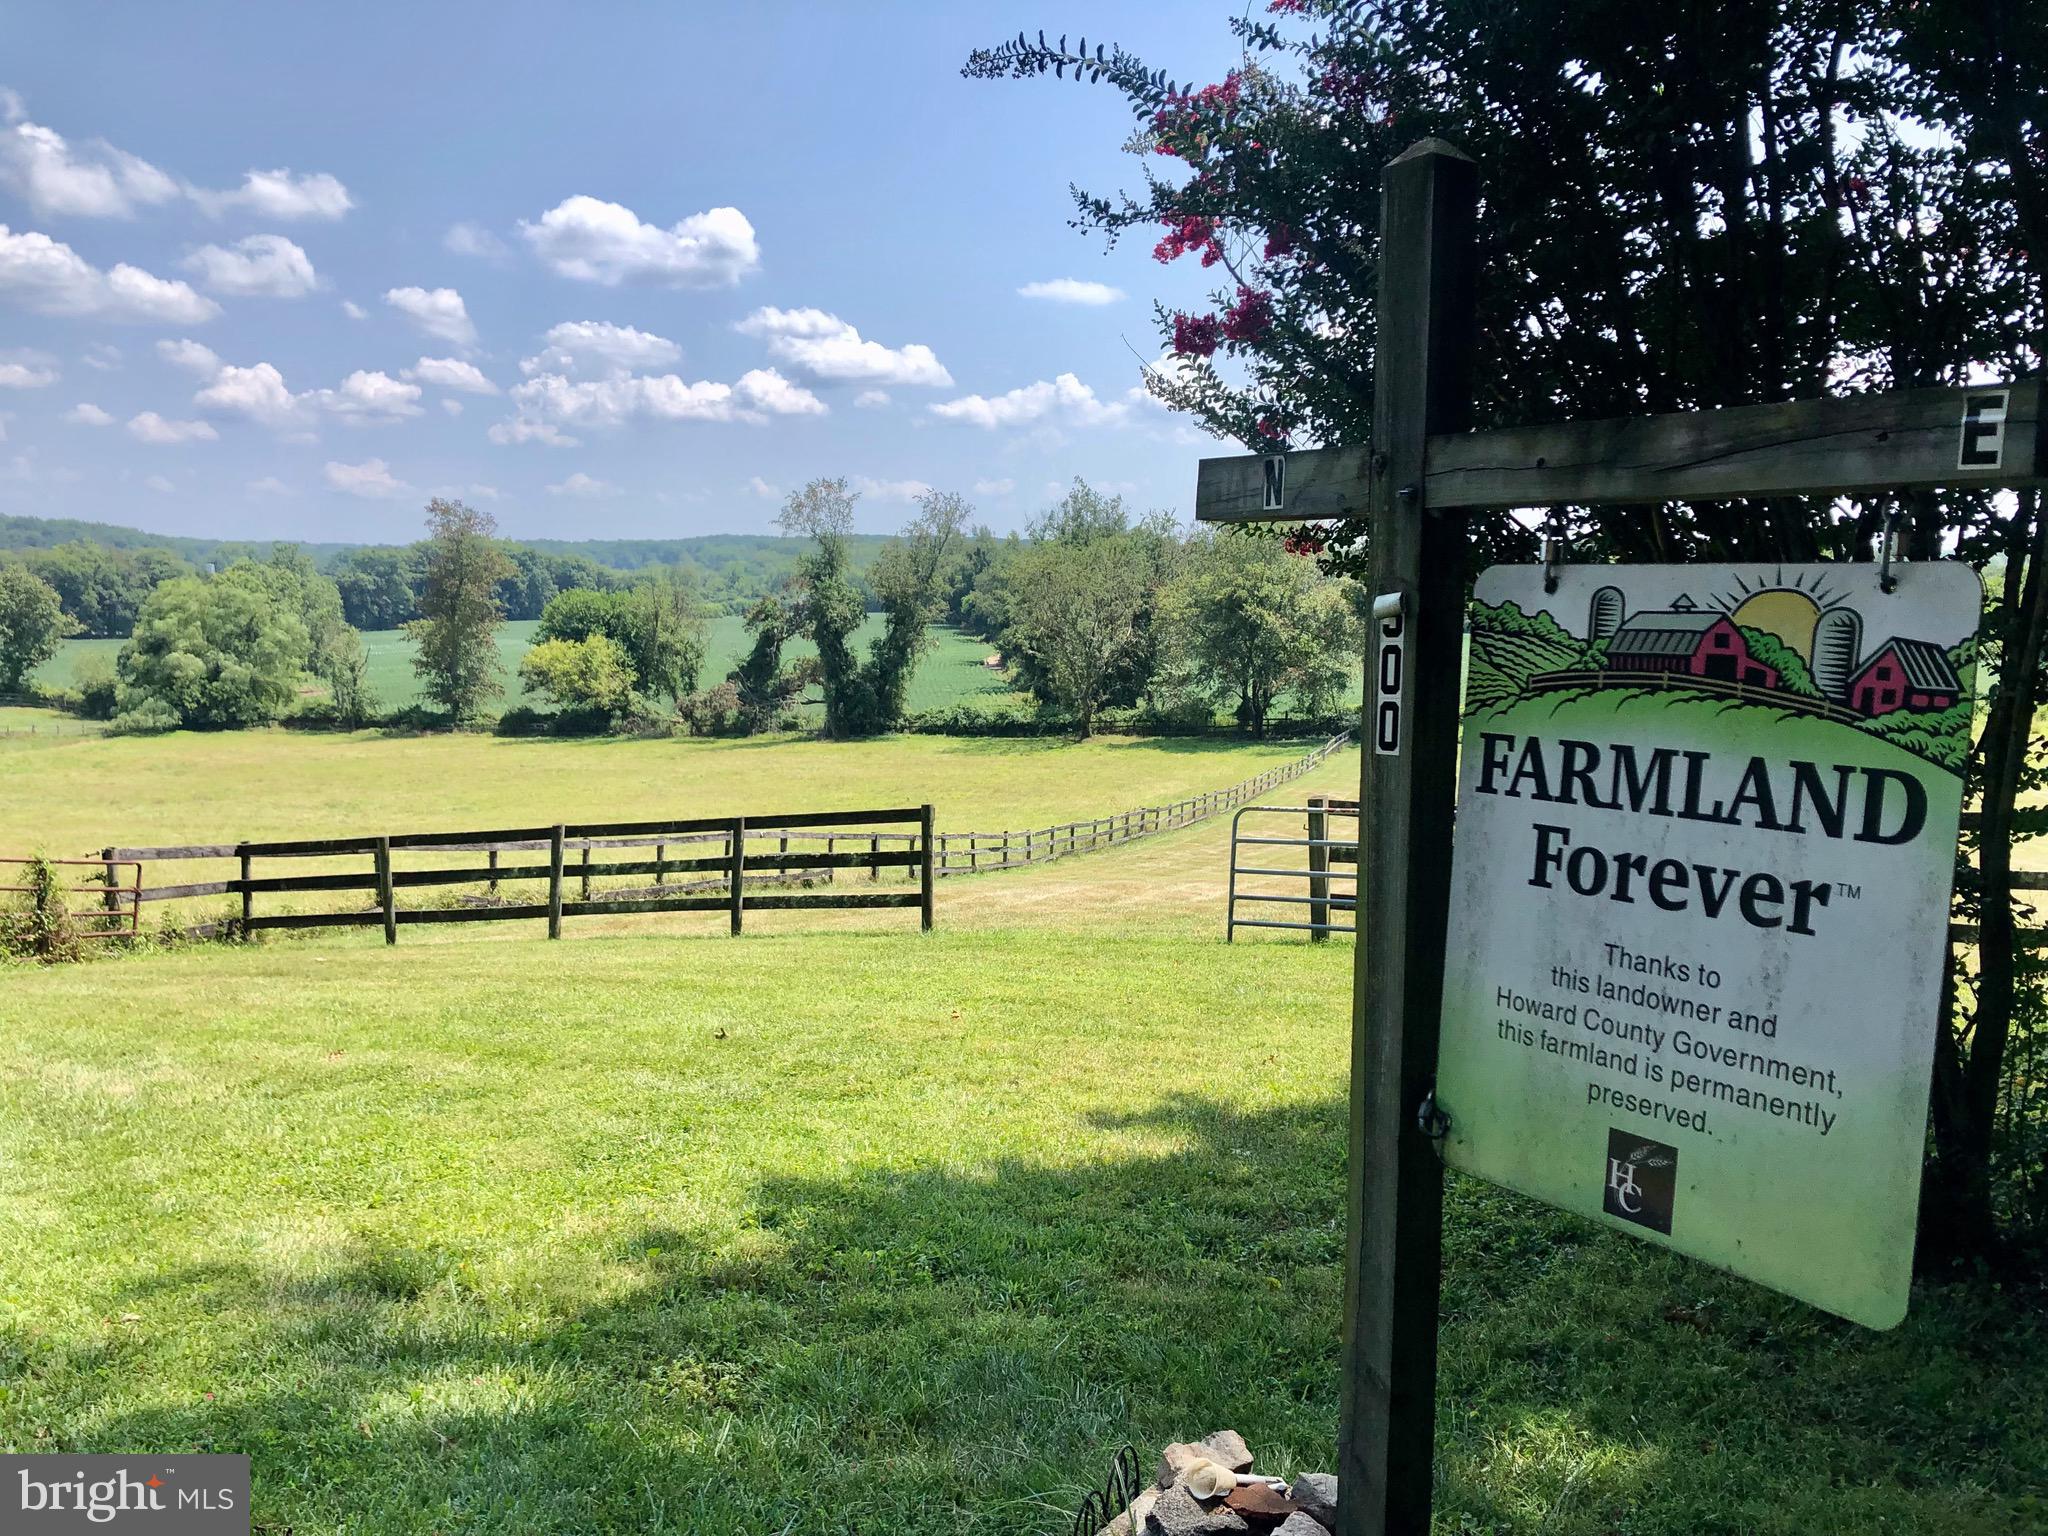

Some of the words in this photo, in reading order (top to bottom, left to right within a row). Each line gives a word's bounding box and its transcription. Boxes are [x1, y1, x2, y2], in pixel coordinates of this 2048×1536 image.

[1960, 394, 2005, 465] E
[1264, 457, 1285, 508] N
[1475, 731, 1928, 845] FARMLAND
[1528, 823, 1832, 936] Forever
[1551, 965, 1589, 993] this
[1597, 975, 1722, 1024] landowner
[1728, 1010, 1778, 1038] and
[1604, 943, 1690, 982] Thanks
[1698, 963, 1721, 989] to
[1496, 986, 1577, 1026] Howard
[1583, 1008, 1665, 1052] County
[1673, 1031, 1843, 1099] Government,
[1497, 1019, 1534, 1047] this
[1540, 1031, 1637, 1076] farmland
[1644, 1057, 1664, 1082] is
[1671, 1069, 1836, 1136] permanently
[1588, 1082, 1713, 1136] preserved.
